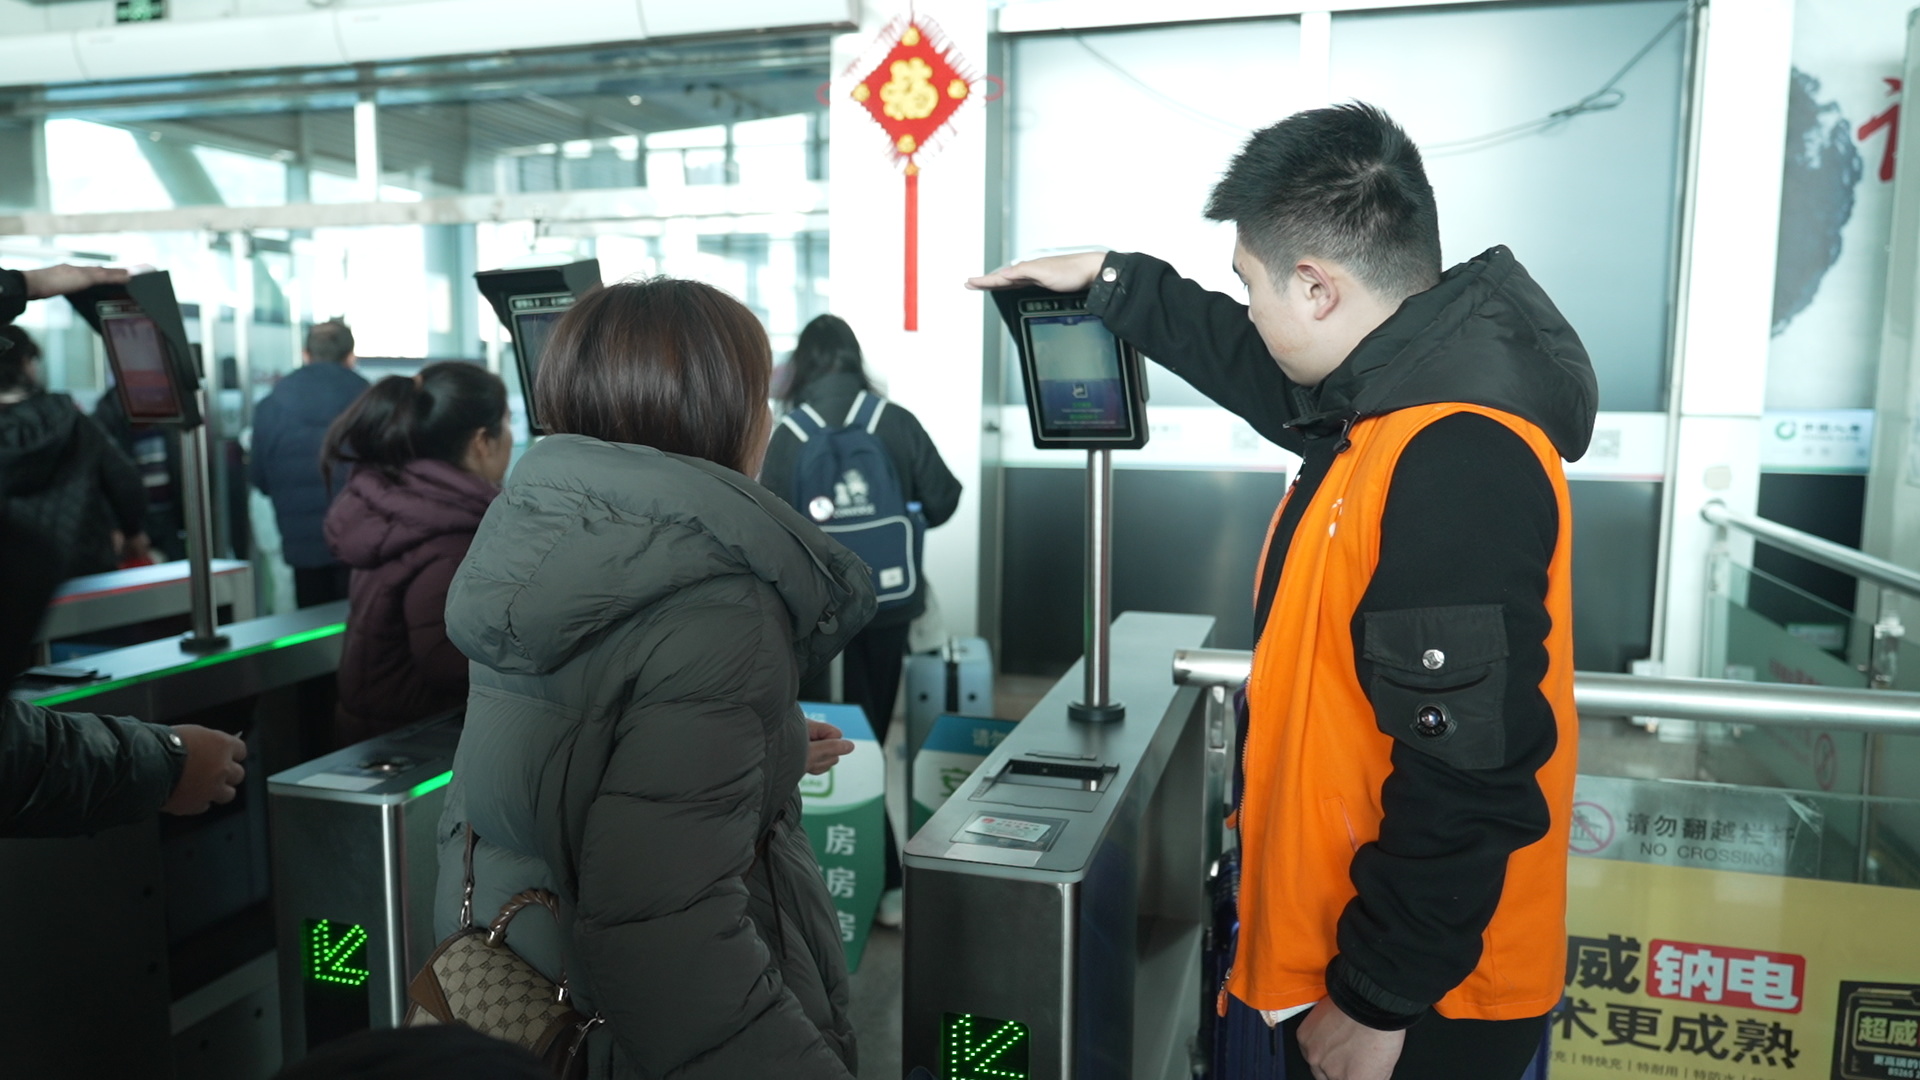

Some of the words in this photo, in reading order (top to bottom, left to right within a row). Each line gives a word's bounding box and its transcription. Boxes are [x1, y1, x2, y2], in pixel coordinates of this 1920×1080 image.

[825, 824, 855, 856] 房
[1626, 812, 1795, 848] 请勿翻越栏杆
[1639, 841, 1667, 857] NO
[1677, 844, 1775, 867] CROSSING
[1653, 944, 1799, 1010] 钠电
[1551, 995, 1801, 1069] 术更成熟
